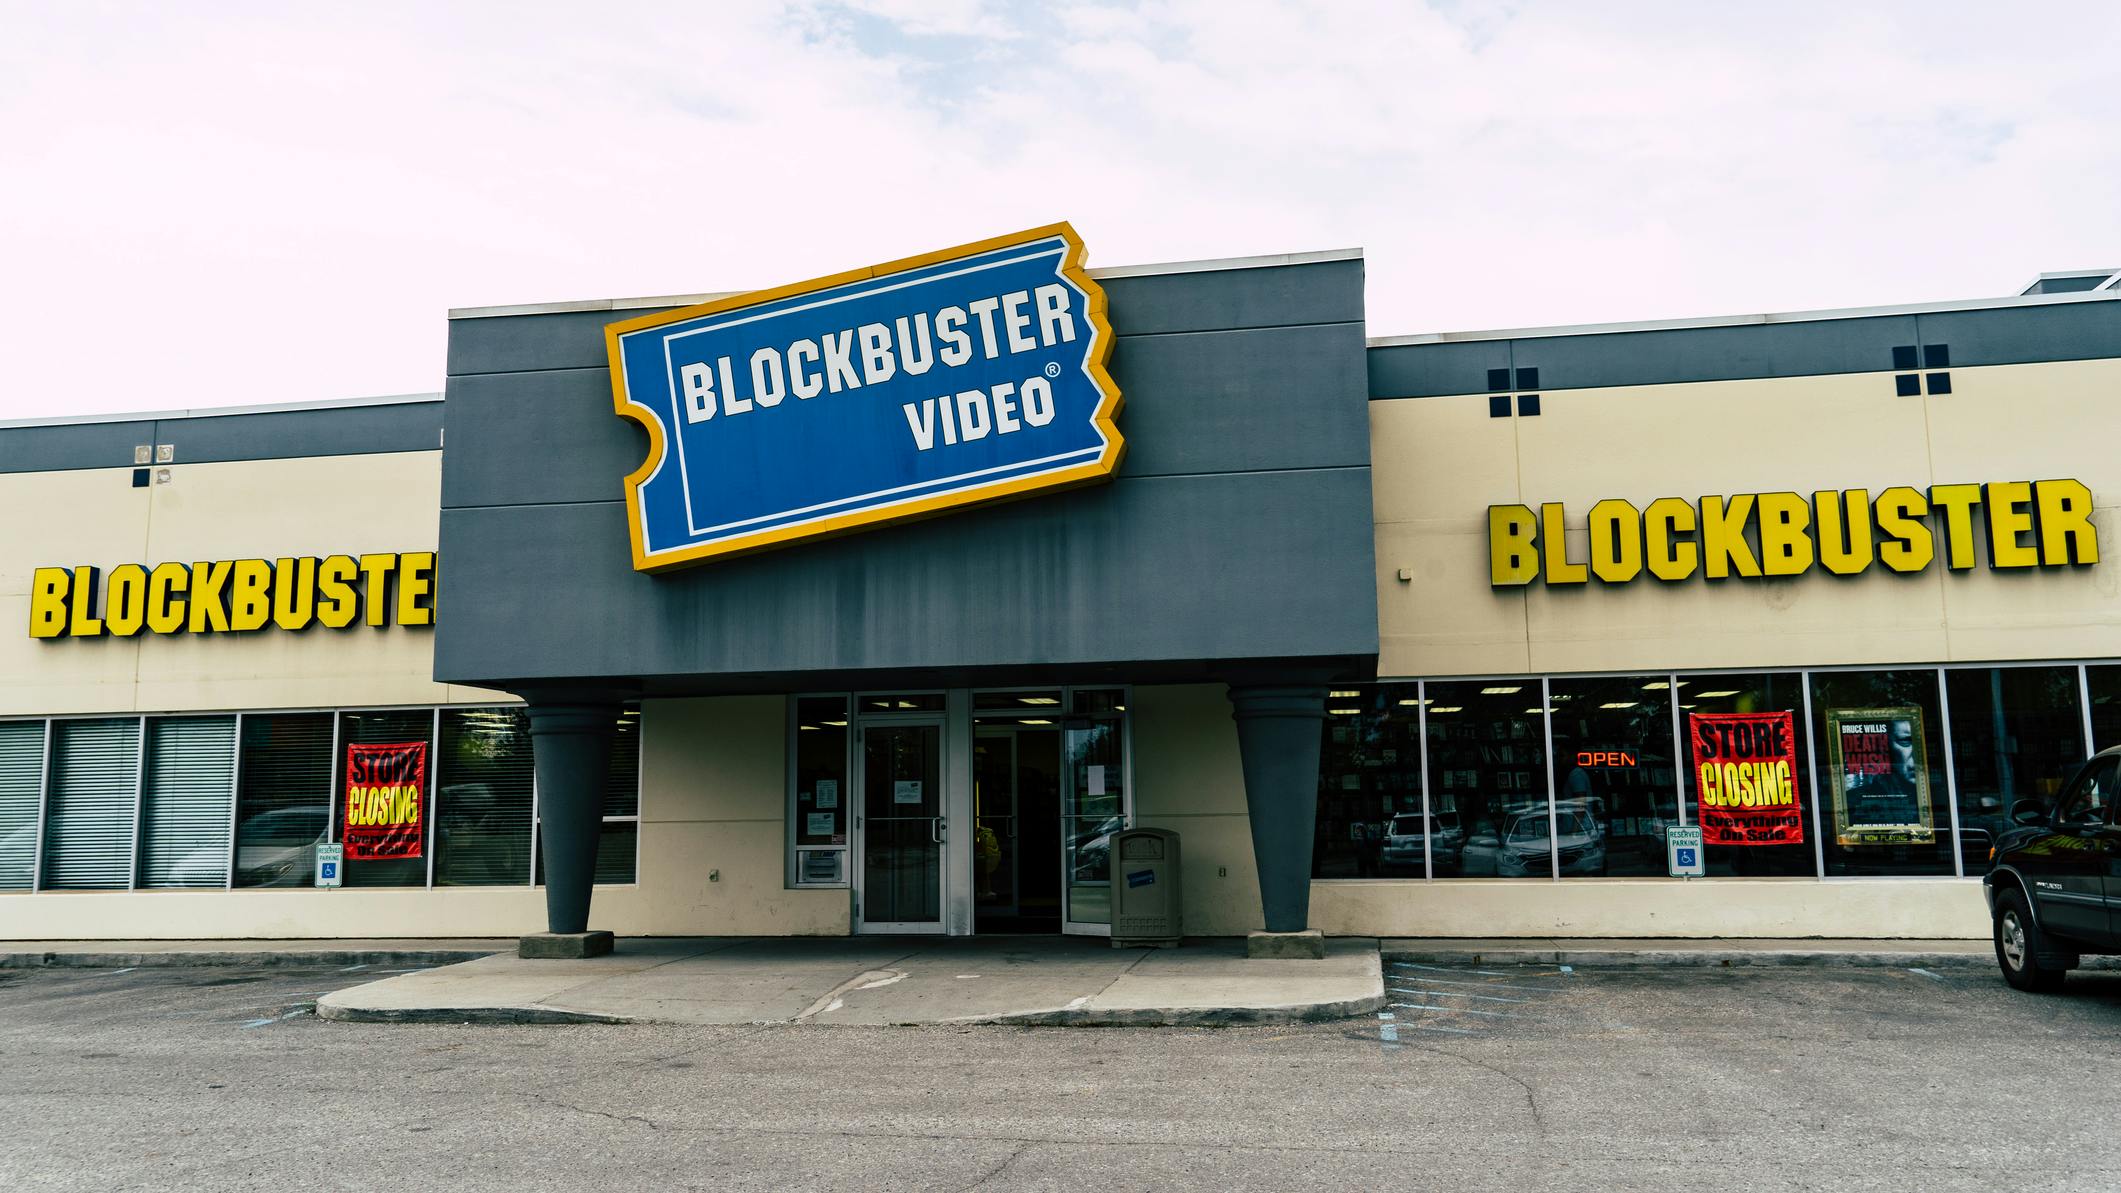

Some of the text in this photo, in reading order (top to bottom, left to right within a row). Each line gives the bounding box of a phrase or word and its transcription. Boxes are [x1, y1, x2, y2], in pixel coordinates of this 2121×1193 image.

[680, 282, 1077, 425] BLOCKBUSTER
[1488, 478, 2100, 588] BLOCKBUSTER
[29, 551, 439, 639] BLOCKBUSTE
[1698, 722, 1787, 758] STORE
[1842, 724, 1887, 734] BRUCE WILLIS
[1843, 734, 1889, 753] DEATH
[353, 751, 419, 783] STORE
[1577, 752, 1635, 766] OPEN
[1846, 753, 1892, 775] WISH
[1701, 760, 1793, 807] CLOSING
[349, 785, 418, 826] CLOSING
[1705, 814, 1798, 828] Everything
[1720, 828, 1787, 841] On Sale
